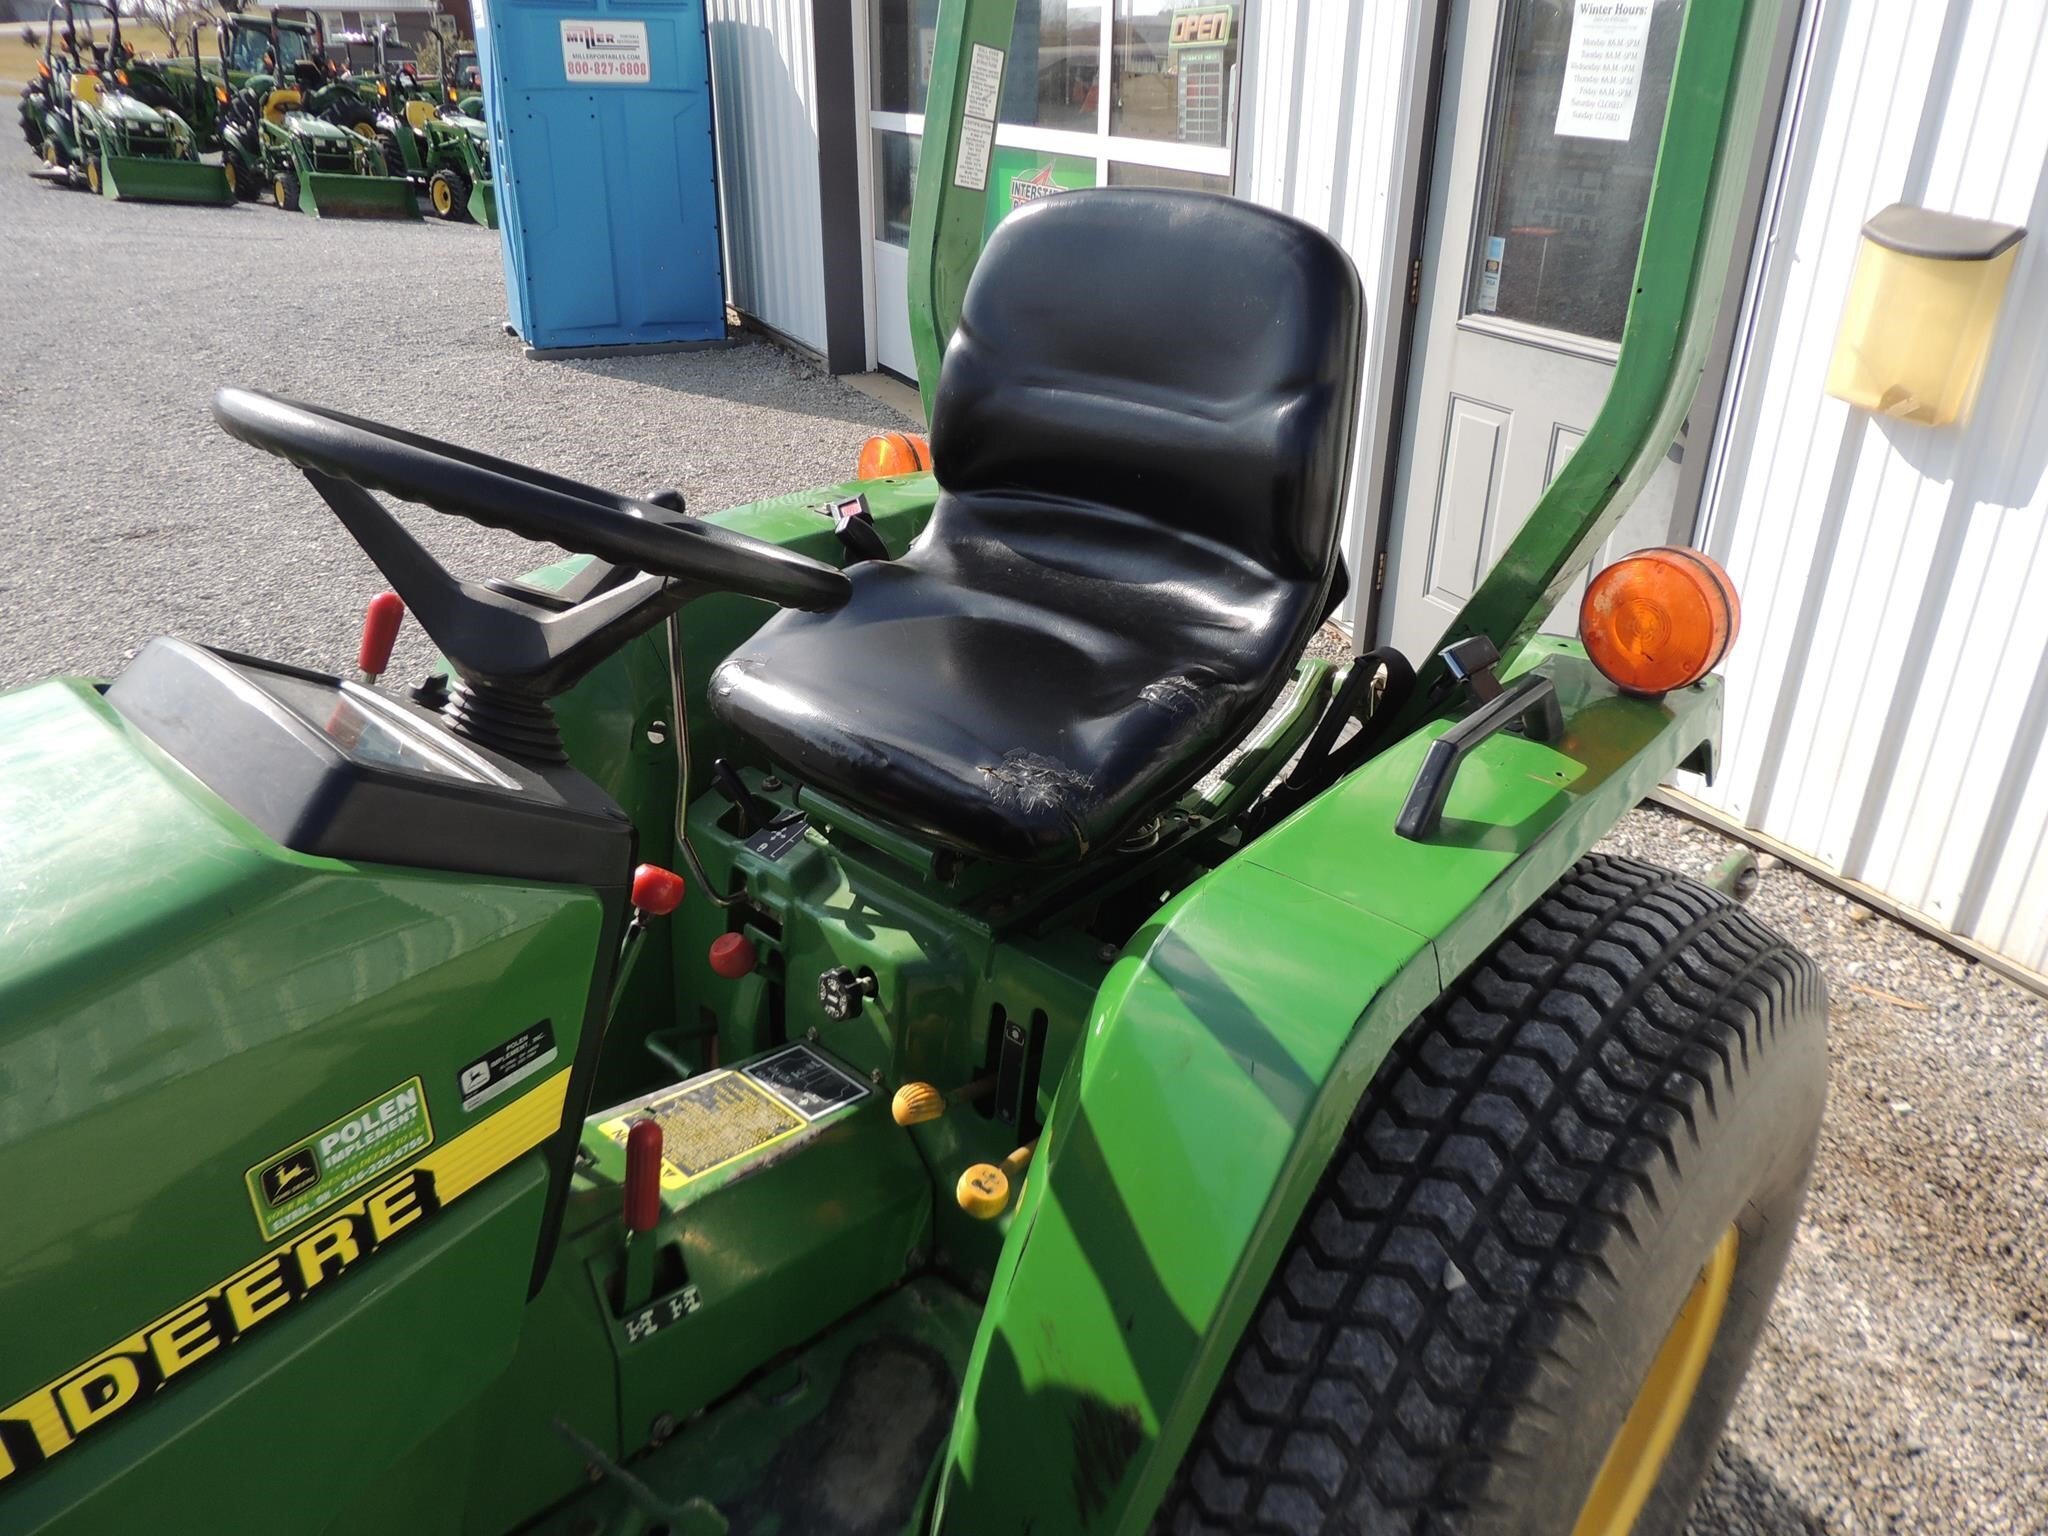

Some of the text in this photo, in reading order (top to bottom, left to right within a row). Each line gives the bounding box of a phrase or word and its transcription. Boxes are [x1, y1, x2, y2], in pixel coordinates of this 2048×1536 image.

[1580, 3, 1648, 16] Winter Hours:
[566, 28, 614, 49] MILLER
[1172, 12, 1228, 43] OPEN
[505, 1033, 529, 1052] POLEN
[318, 1085, 418, 1157] POLEN
[324, 1105, 419, 1169] IMPLEMENT
[54, 1172, 430, 1438] DEERE
